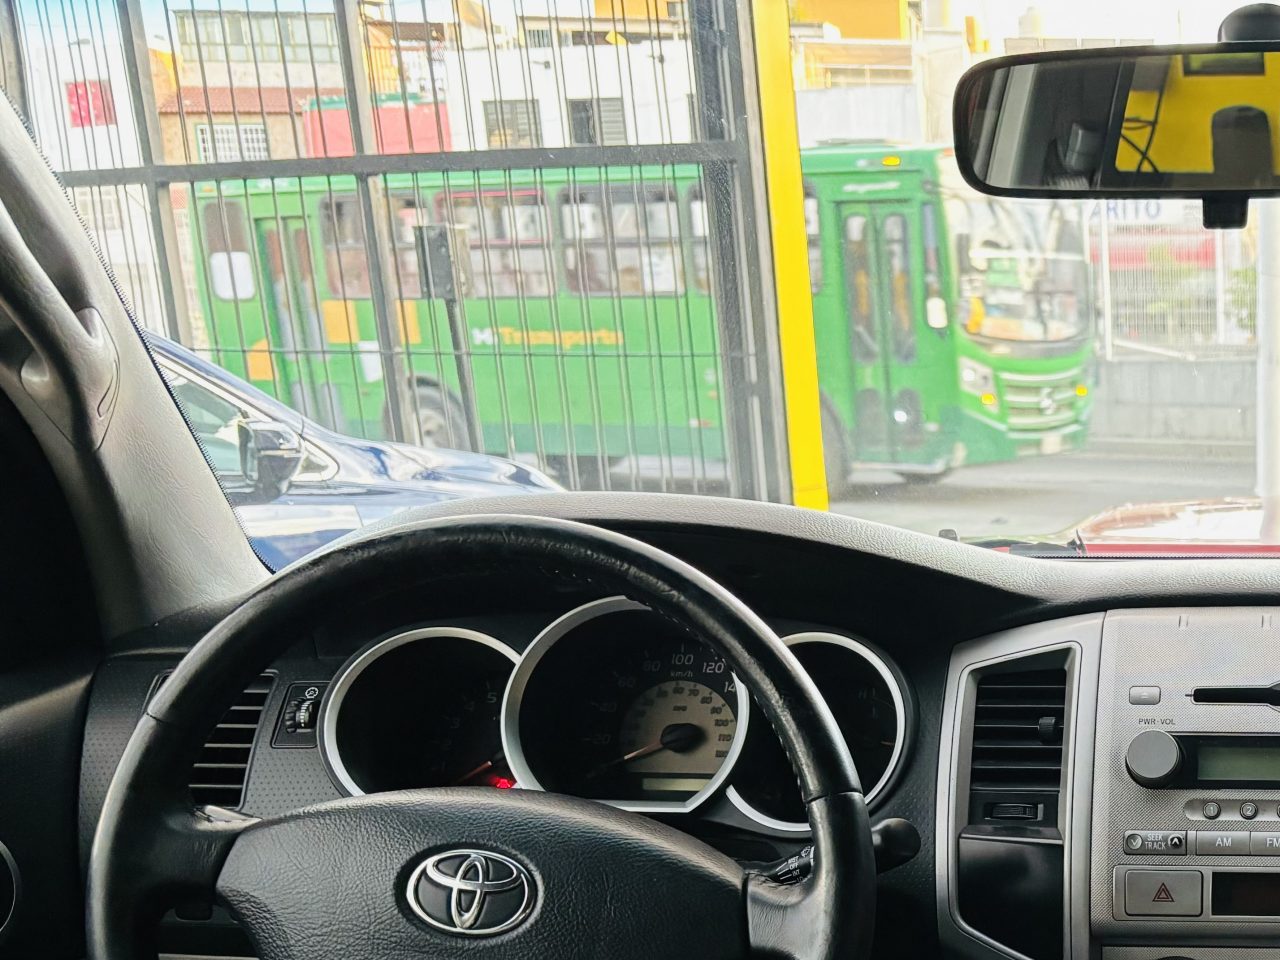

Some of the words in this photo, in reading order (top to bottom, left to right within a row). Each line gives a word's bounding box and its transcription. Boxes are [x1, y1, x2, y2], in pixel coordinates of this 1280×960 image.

[671, 654, 694, 665] 100
[702, 661, 725, 674] 120
[723, 681, 737, 693] 14
[1147, 833, 1164, 842] SEEK
[1215, 837, 1232, 847] AM
[1145, 841, 1167, 851] TRACK
